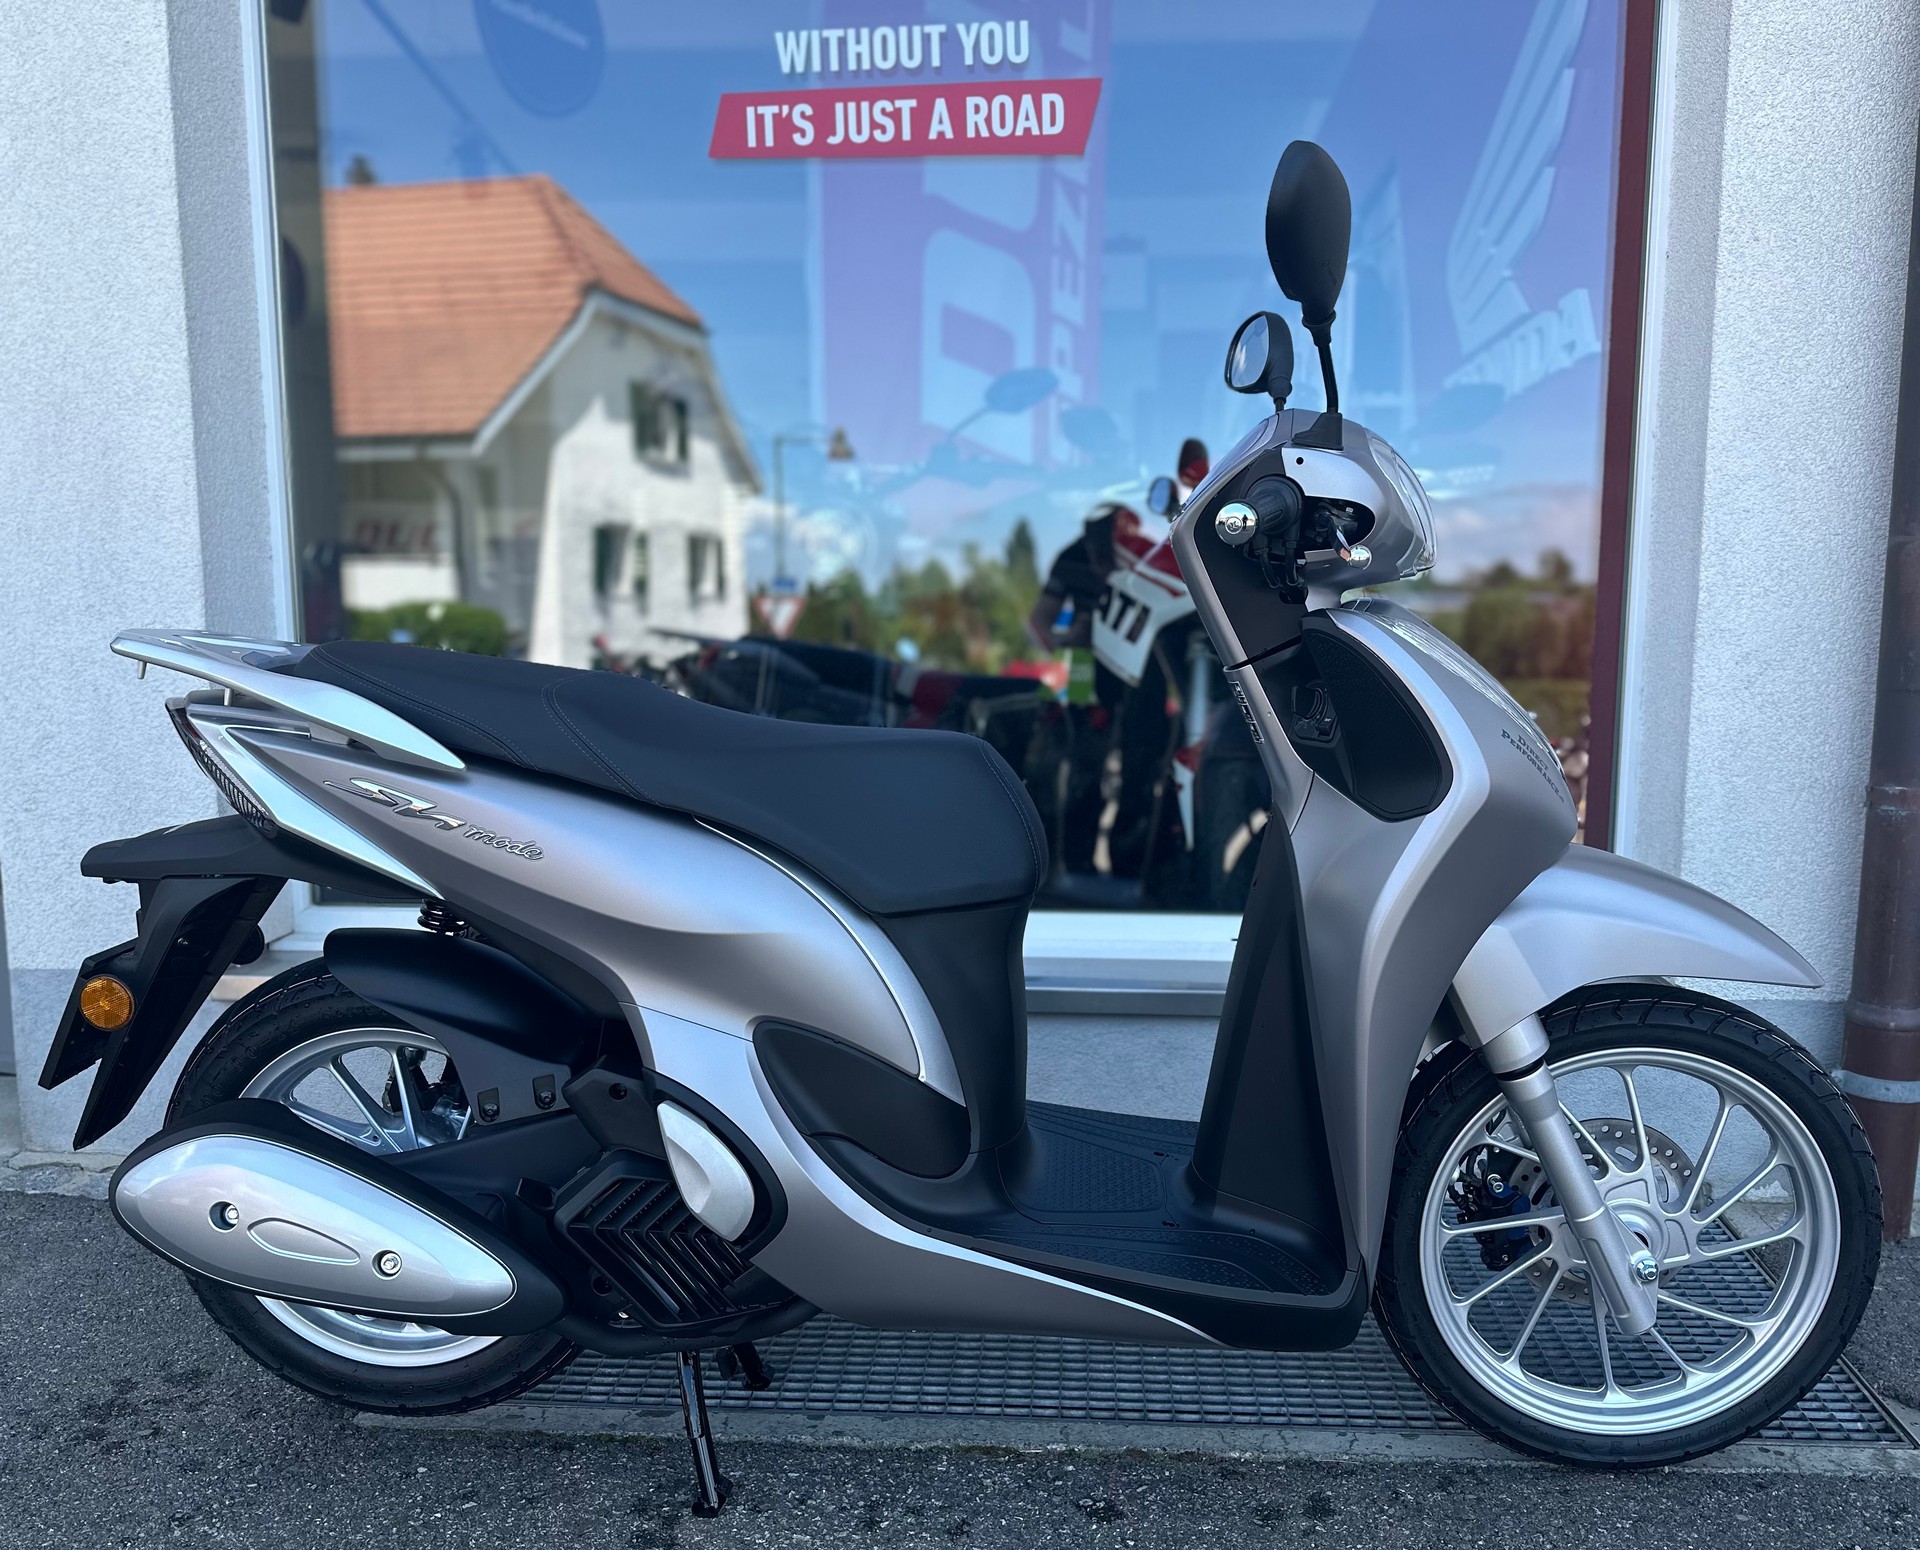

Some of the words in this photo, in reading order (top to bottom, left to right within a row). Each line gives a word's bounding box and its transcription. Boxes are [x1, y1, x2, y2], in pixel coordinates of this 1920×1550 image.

[774, 23, 947, 74] WITHOUT
[955, 19, 1030, 66] YOU
[746, 103, 815, 148] IT'S
[826, 98, 917, 145] JUST
[928, 97, 954, 140] A
[965, 92, 1065, 138] ROAD
[462, 823, 545, 861] mode
